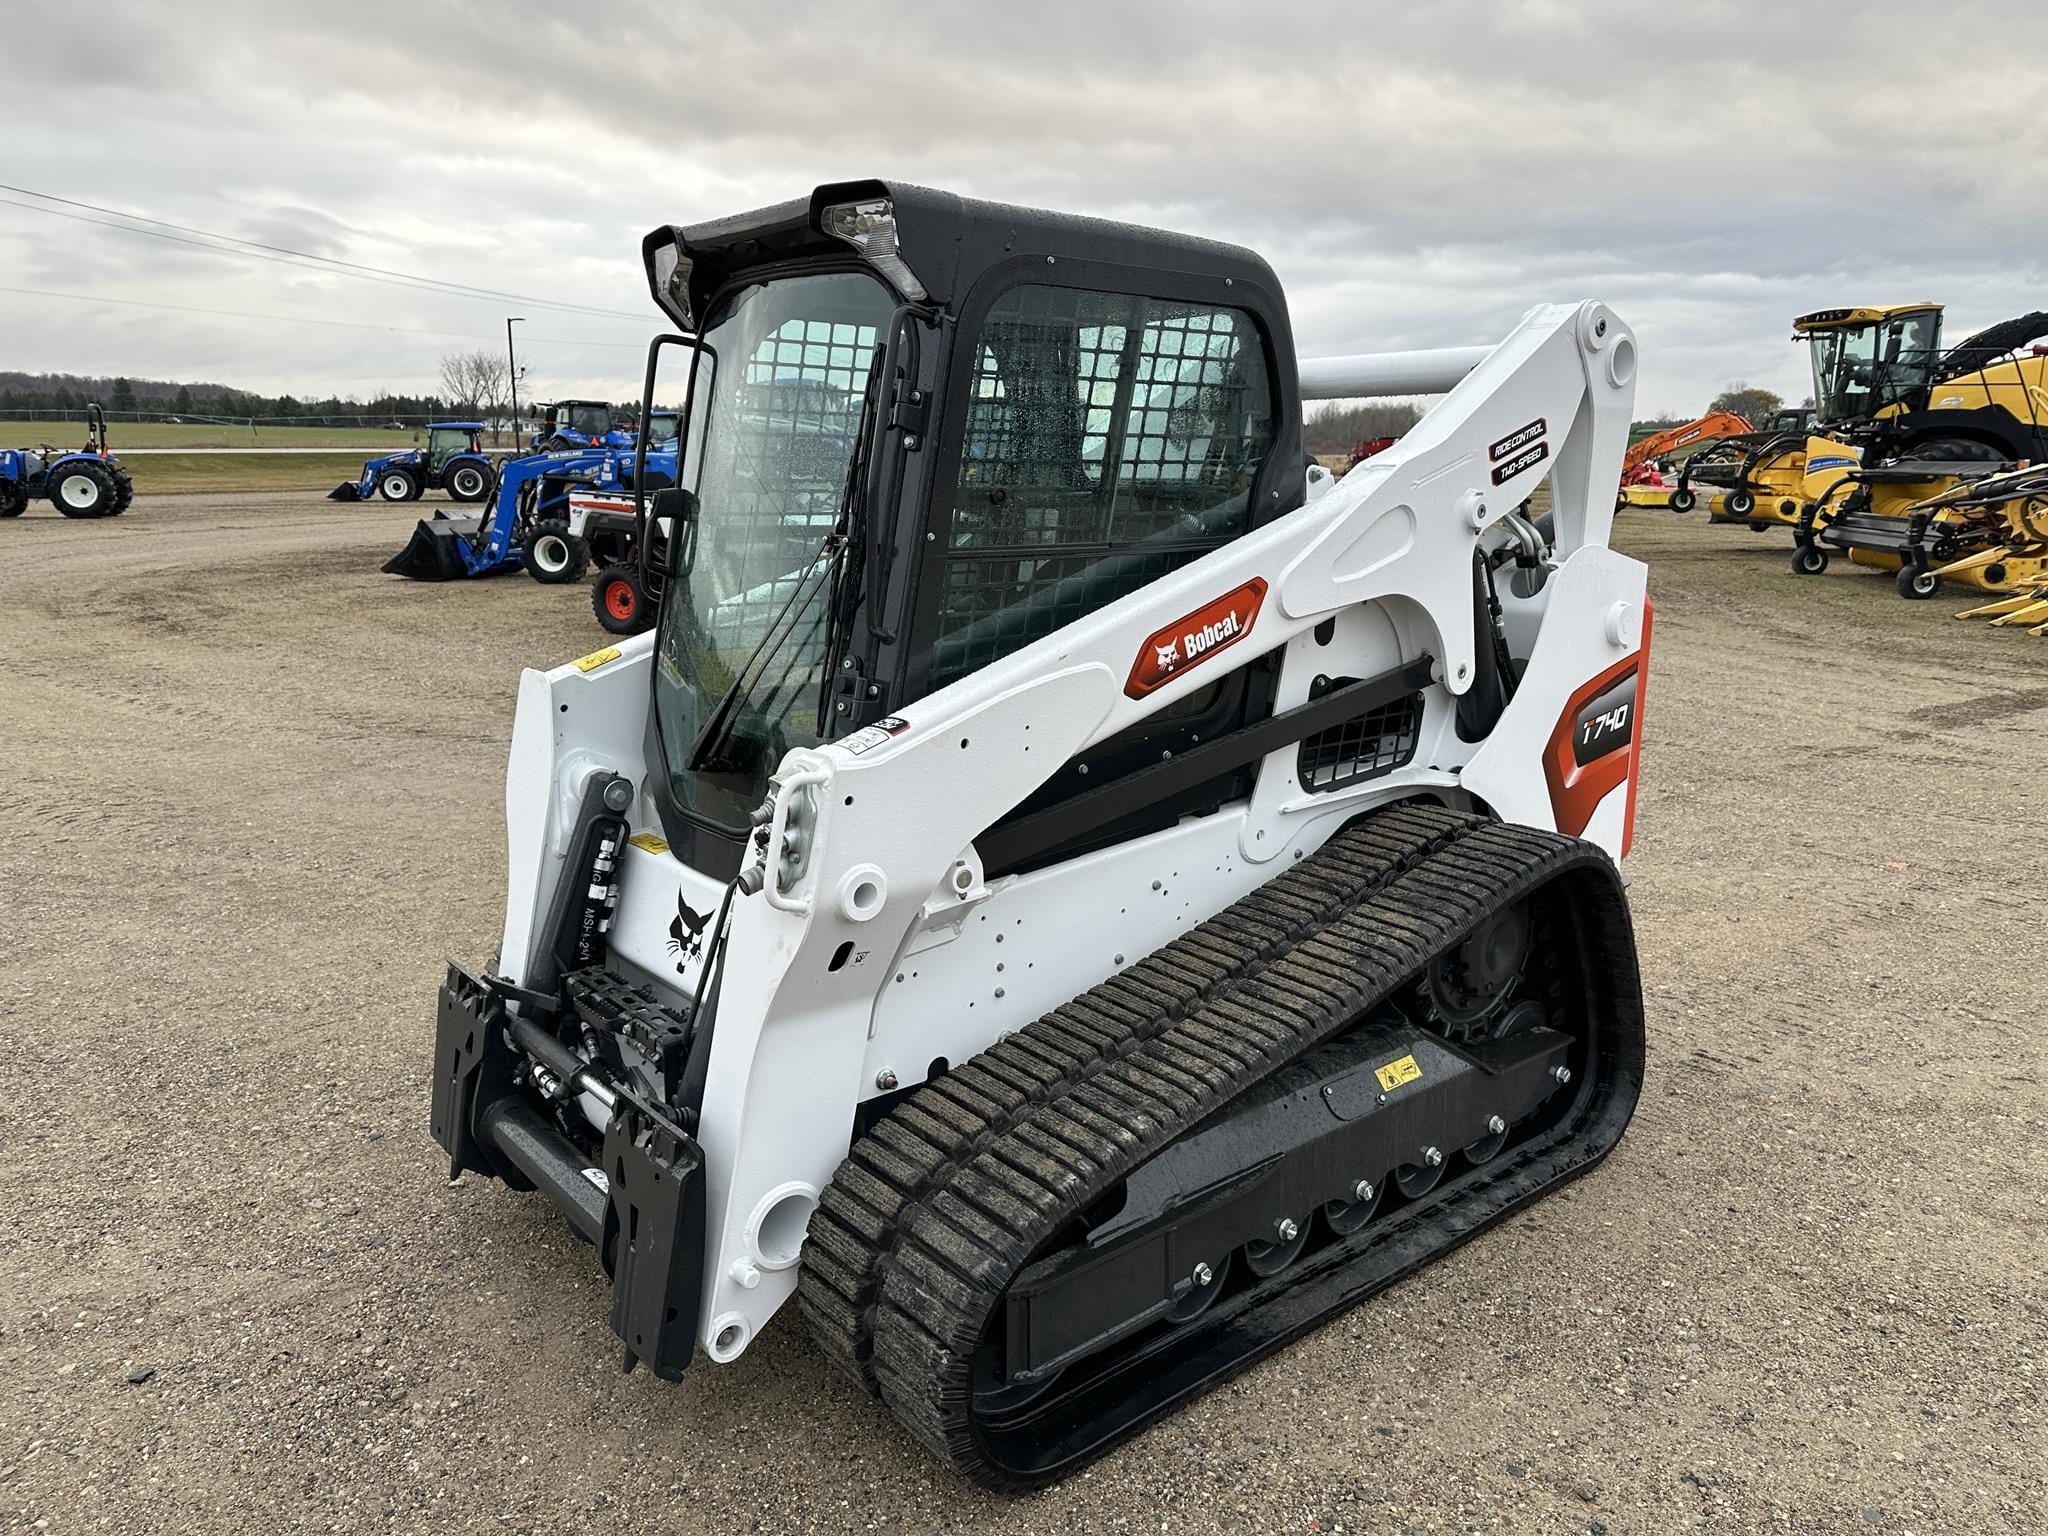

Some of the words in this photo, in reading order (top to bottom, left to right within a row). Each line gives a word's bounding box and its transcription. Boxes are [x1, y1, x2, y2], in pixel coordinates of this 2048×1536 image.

[1494, 440, 1512, 457] RIDE
[1511, 423, 1543, 448] CONTROL
[1501, 447, 1542, 479] TWO-SPEED
[1183, 610, 1240, 659] Bobcat
